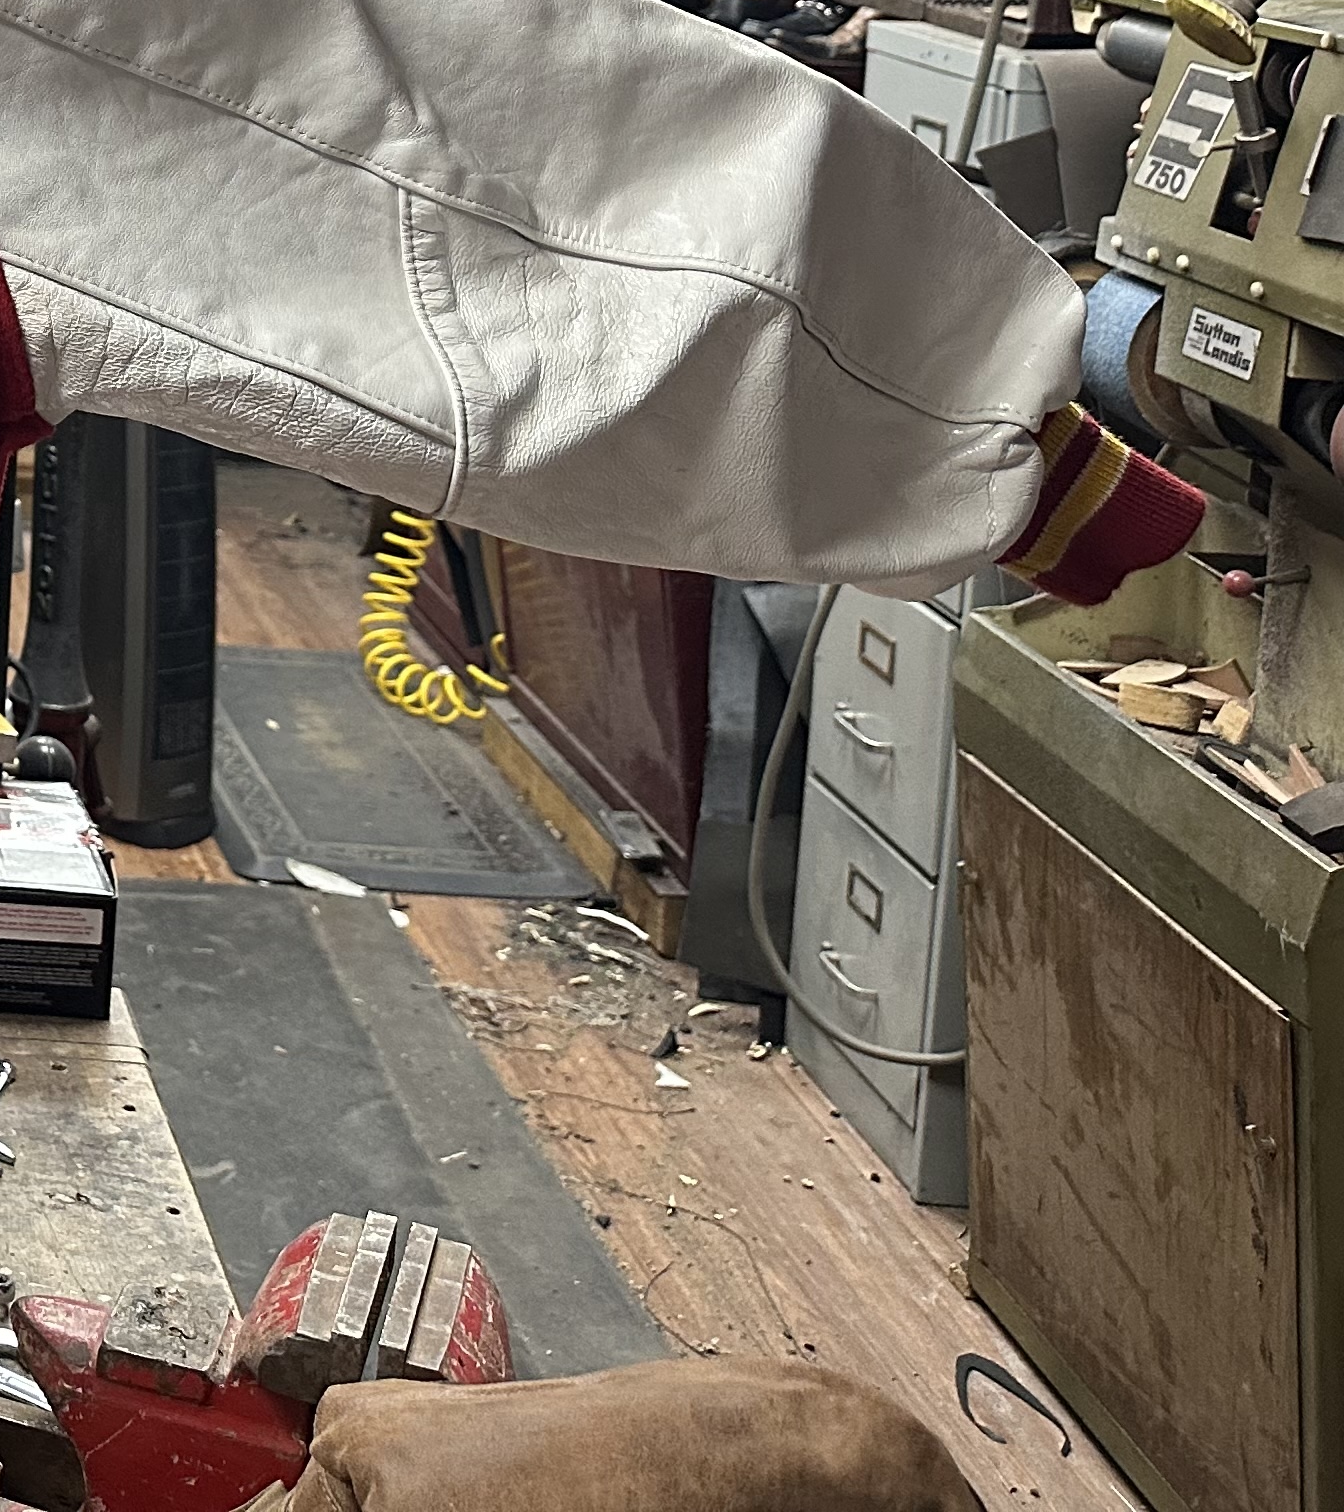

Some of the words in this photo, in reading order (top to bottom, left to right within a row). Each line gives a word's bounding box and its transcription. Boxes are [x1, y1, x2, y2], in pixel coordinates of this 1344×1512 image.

[1144, 159, 1186, 194] 750
[1193, 313, 1241, 347] Sutton
[1202, 337, 1252, 371] Landis
